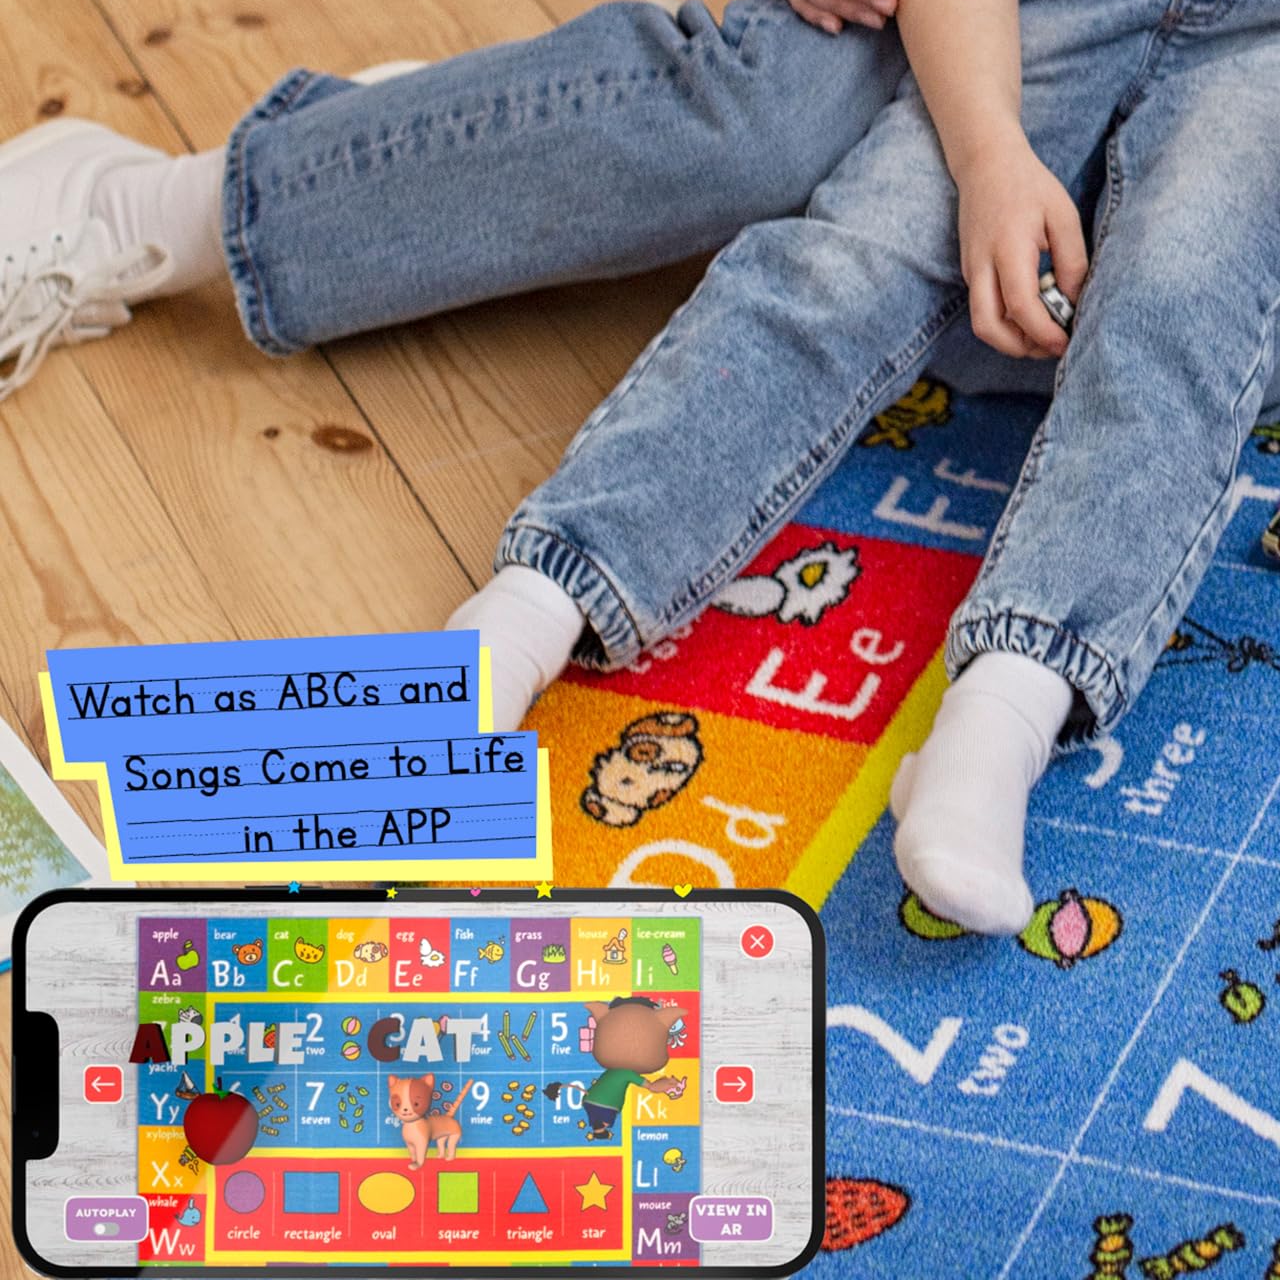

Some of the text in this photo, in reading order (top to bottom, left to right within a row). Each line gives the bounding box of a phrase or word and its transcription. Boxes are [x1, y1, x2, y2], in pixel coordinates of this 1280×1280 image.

[1123, 722, 1206, 818] three
[152, 929, 179, 941] apple
[213, 929, 237, 940] bear
[274, 930, 289, 940] cat
[335, 929, 355, 943] dog
[395, 930, 414, 943] egg
[455, 928, 474, 940] fish
[515, 930, 542, 943] grass
[578, 929, 608, 939] house
[636, 928, 686, 939] ice-cream
[150, 959, 182, 987] Aa
[212, 960, 245, 987] Bb
[335, 960, 367, 987] Dd
[394, 960, 423, 987] Ee
[516, 960, 550, 991] Gg
[577, 960, 610, 987] Hh
[152, 993, 181, 1004] zebra
[306, 1013, 324, 1042] 2
[552, 1012, 568, 1042] 5
[129, 1017, 482, 1065] APPLE CAT
[306, 1046, 325, 1056] two
[552, 1044, 571, 1055] five
[957, 1023, 1030, 1098] two
[305, 1081, 325, 1111] 7
[471, 1081, 490, 1111] 9
[150, 1093, 180, 1124] Yy
[636, 1093, 667, 1120] Kk
[301, 1116, 331, 1125] seven
[385, 1115, 402, 1128] eig
[470, 1115, 493, 1125] nine
[553, 1114, 570, 1124] ten
[146, 1128, 184, 1142] xylopho
[637, 1129, 668, 1141] lemon
[151, 1161, 183, 1188] Xx
[149, 1196, 178, 1208] whale
[639, 1201, 671, 1210] mouse
[75, 1208, 137, 1218] AUTOPLAY
[696, 1204, 768, 1217] VIEW IN
[227, 1226, 260, 1240] circle
[284, 1226, 342, 1244] rectangle
[371, 1226, 396, 1240] oval
[438, 1228, 479, 1244] square
[507, 1226, 553, 1244] triangle
[582, 1226, 606, 1239] star
[720, 1223, 742, 1236] AR
[636, 1228, 682, 1255] Mm
